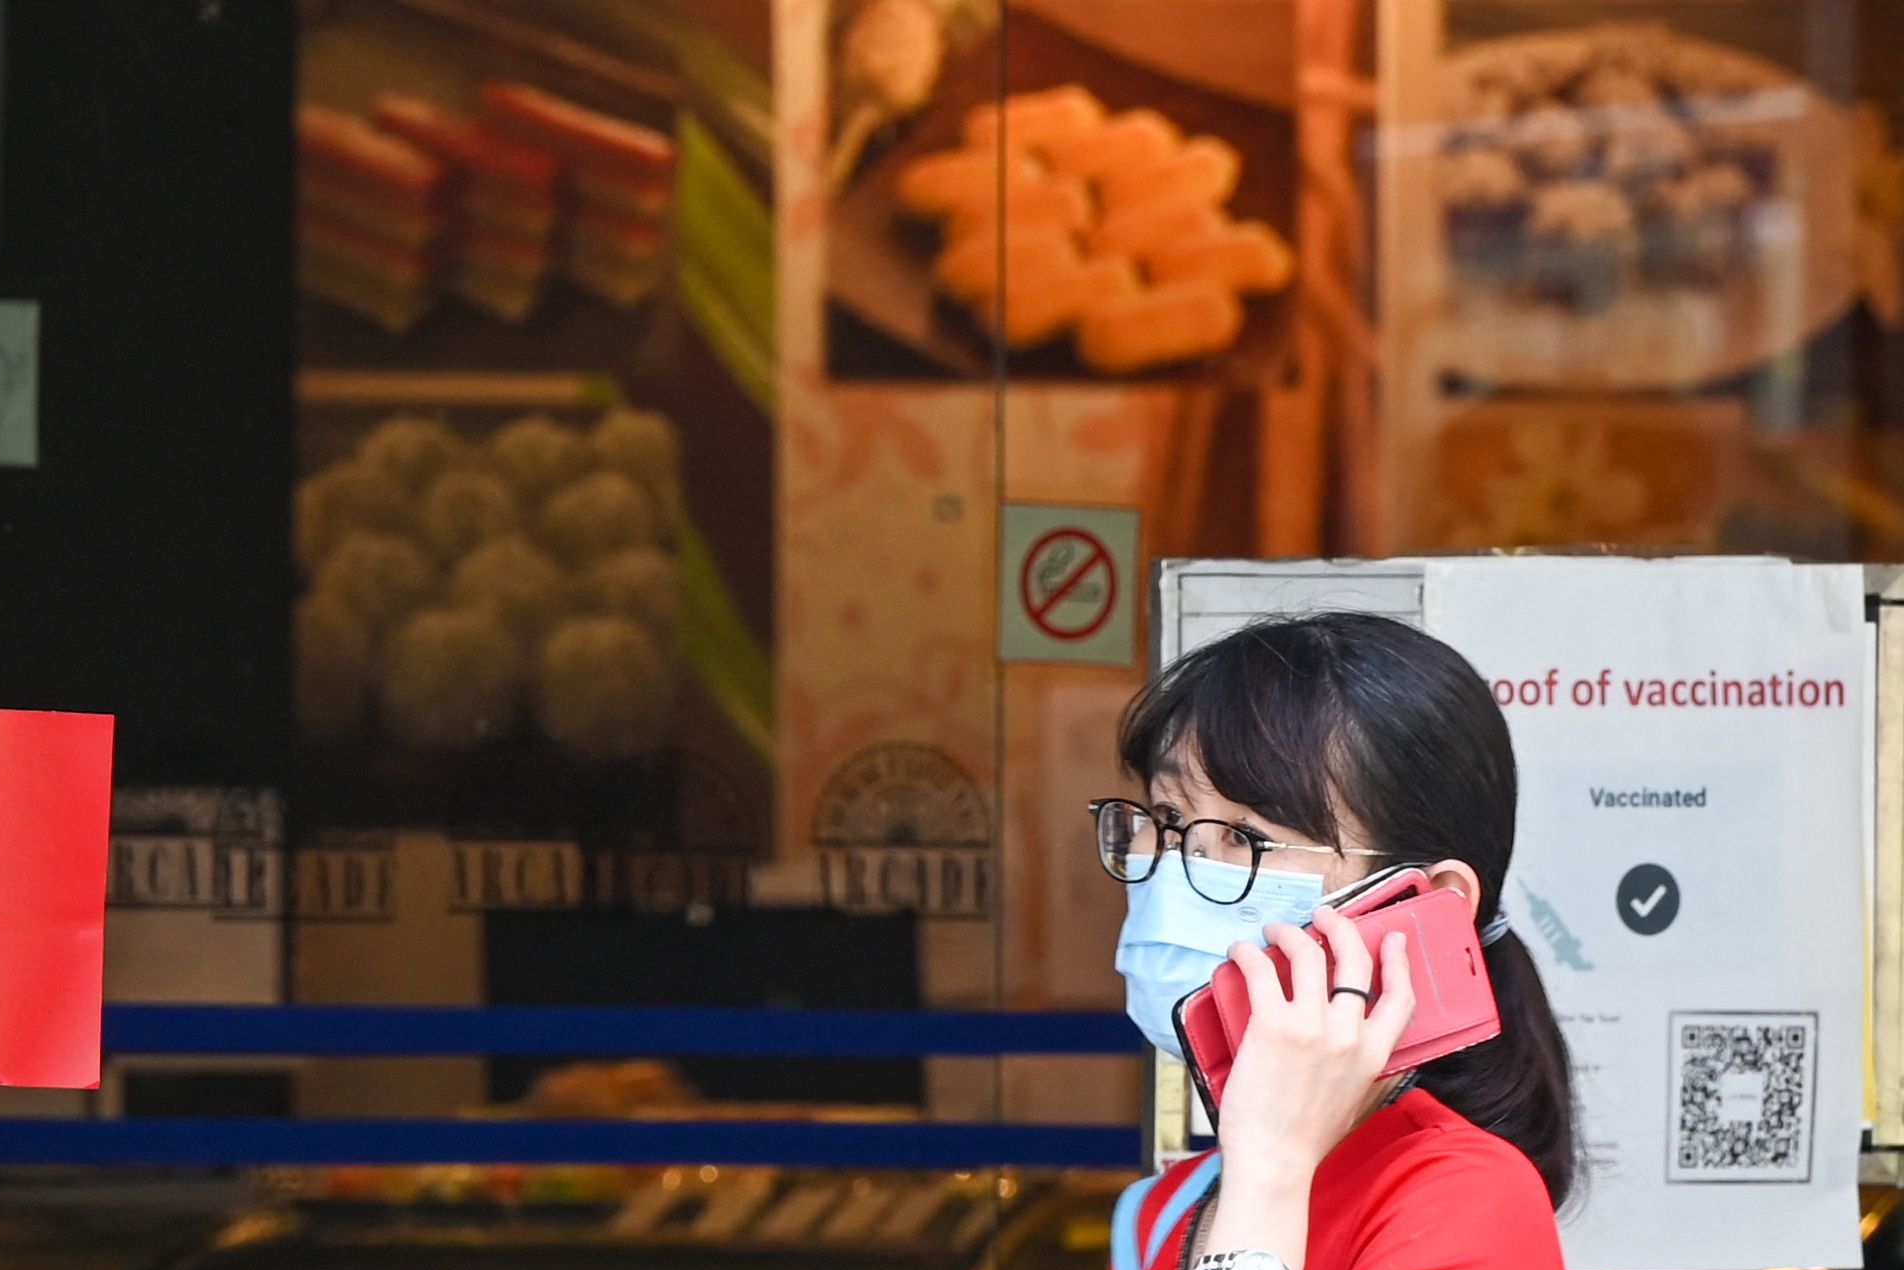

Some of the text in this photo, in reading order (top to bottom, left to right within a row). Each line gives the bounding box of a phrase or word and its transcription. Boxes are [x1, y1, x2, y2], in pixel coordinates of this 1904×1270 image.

[1486, 668, 1846, 708] oof of vaccination
[1590, 787, 1708, 809] Vaccinated
